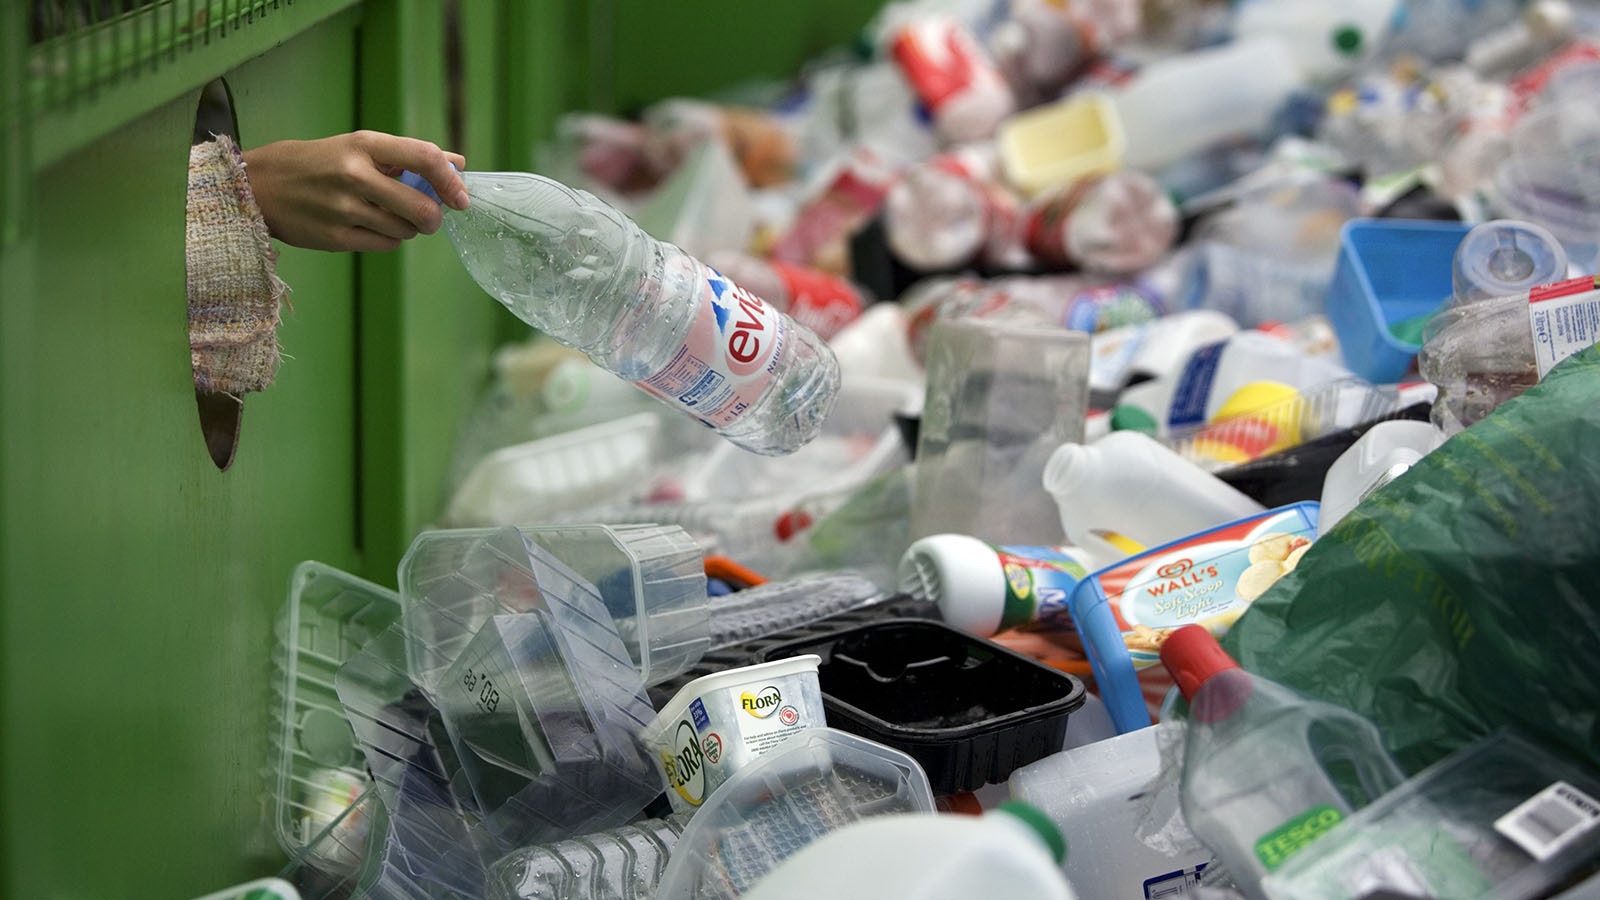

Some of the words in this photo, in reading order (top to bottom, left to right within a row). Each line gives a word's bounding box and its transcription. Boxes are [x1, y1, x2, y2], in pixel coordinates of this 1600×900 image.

[728, 283, 765, 363] evia
[767, 336, 783, 374] Natural
[1147, 566, 1218, 597] WALL'S
[1154, 596, 1182, 616] Soft
[1184, 579, 1223, 602] Scoop
[1177, 597, 1213, 619] Light
[742, 693, 782, 710] FLORA
[1256, 808, 1341, 866] TESCO
